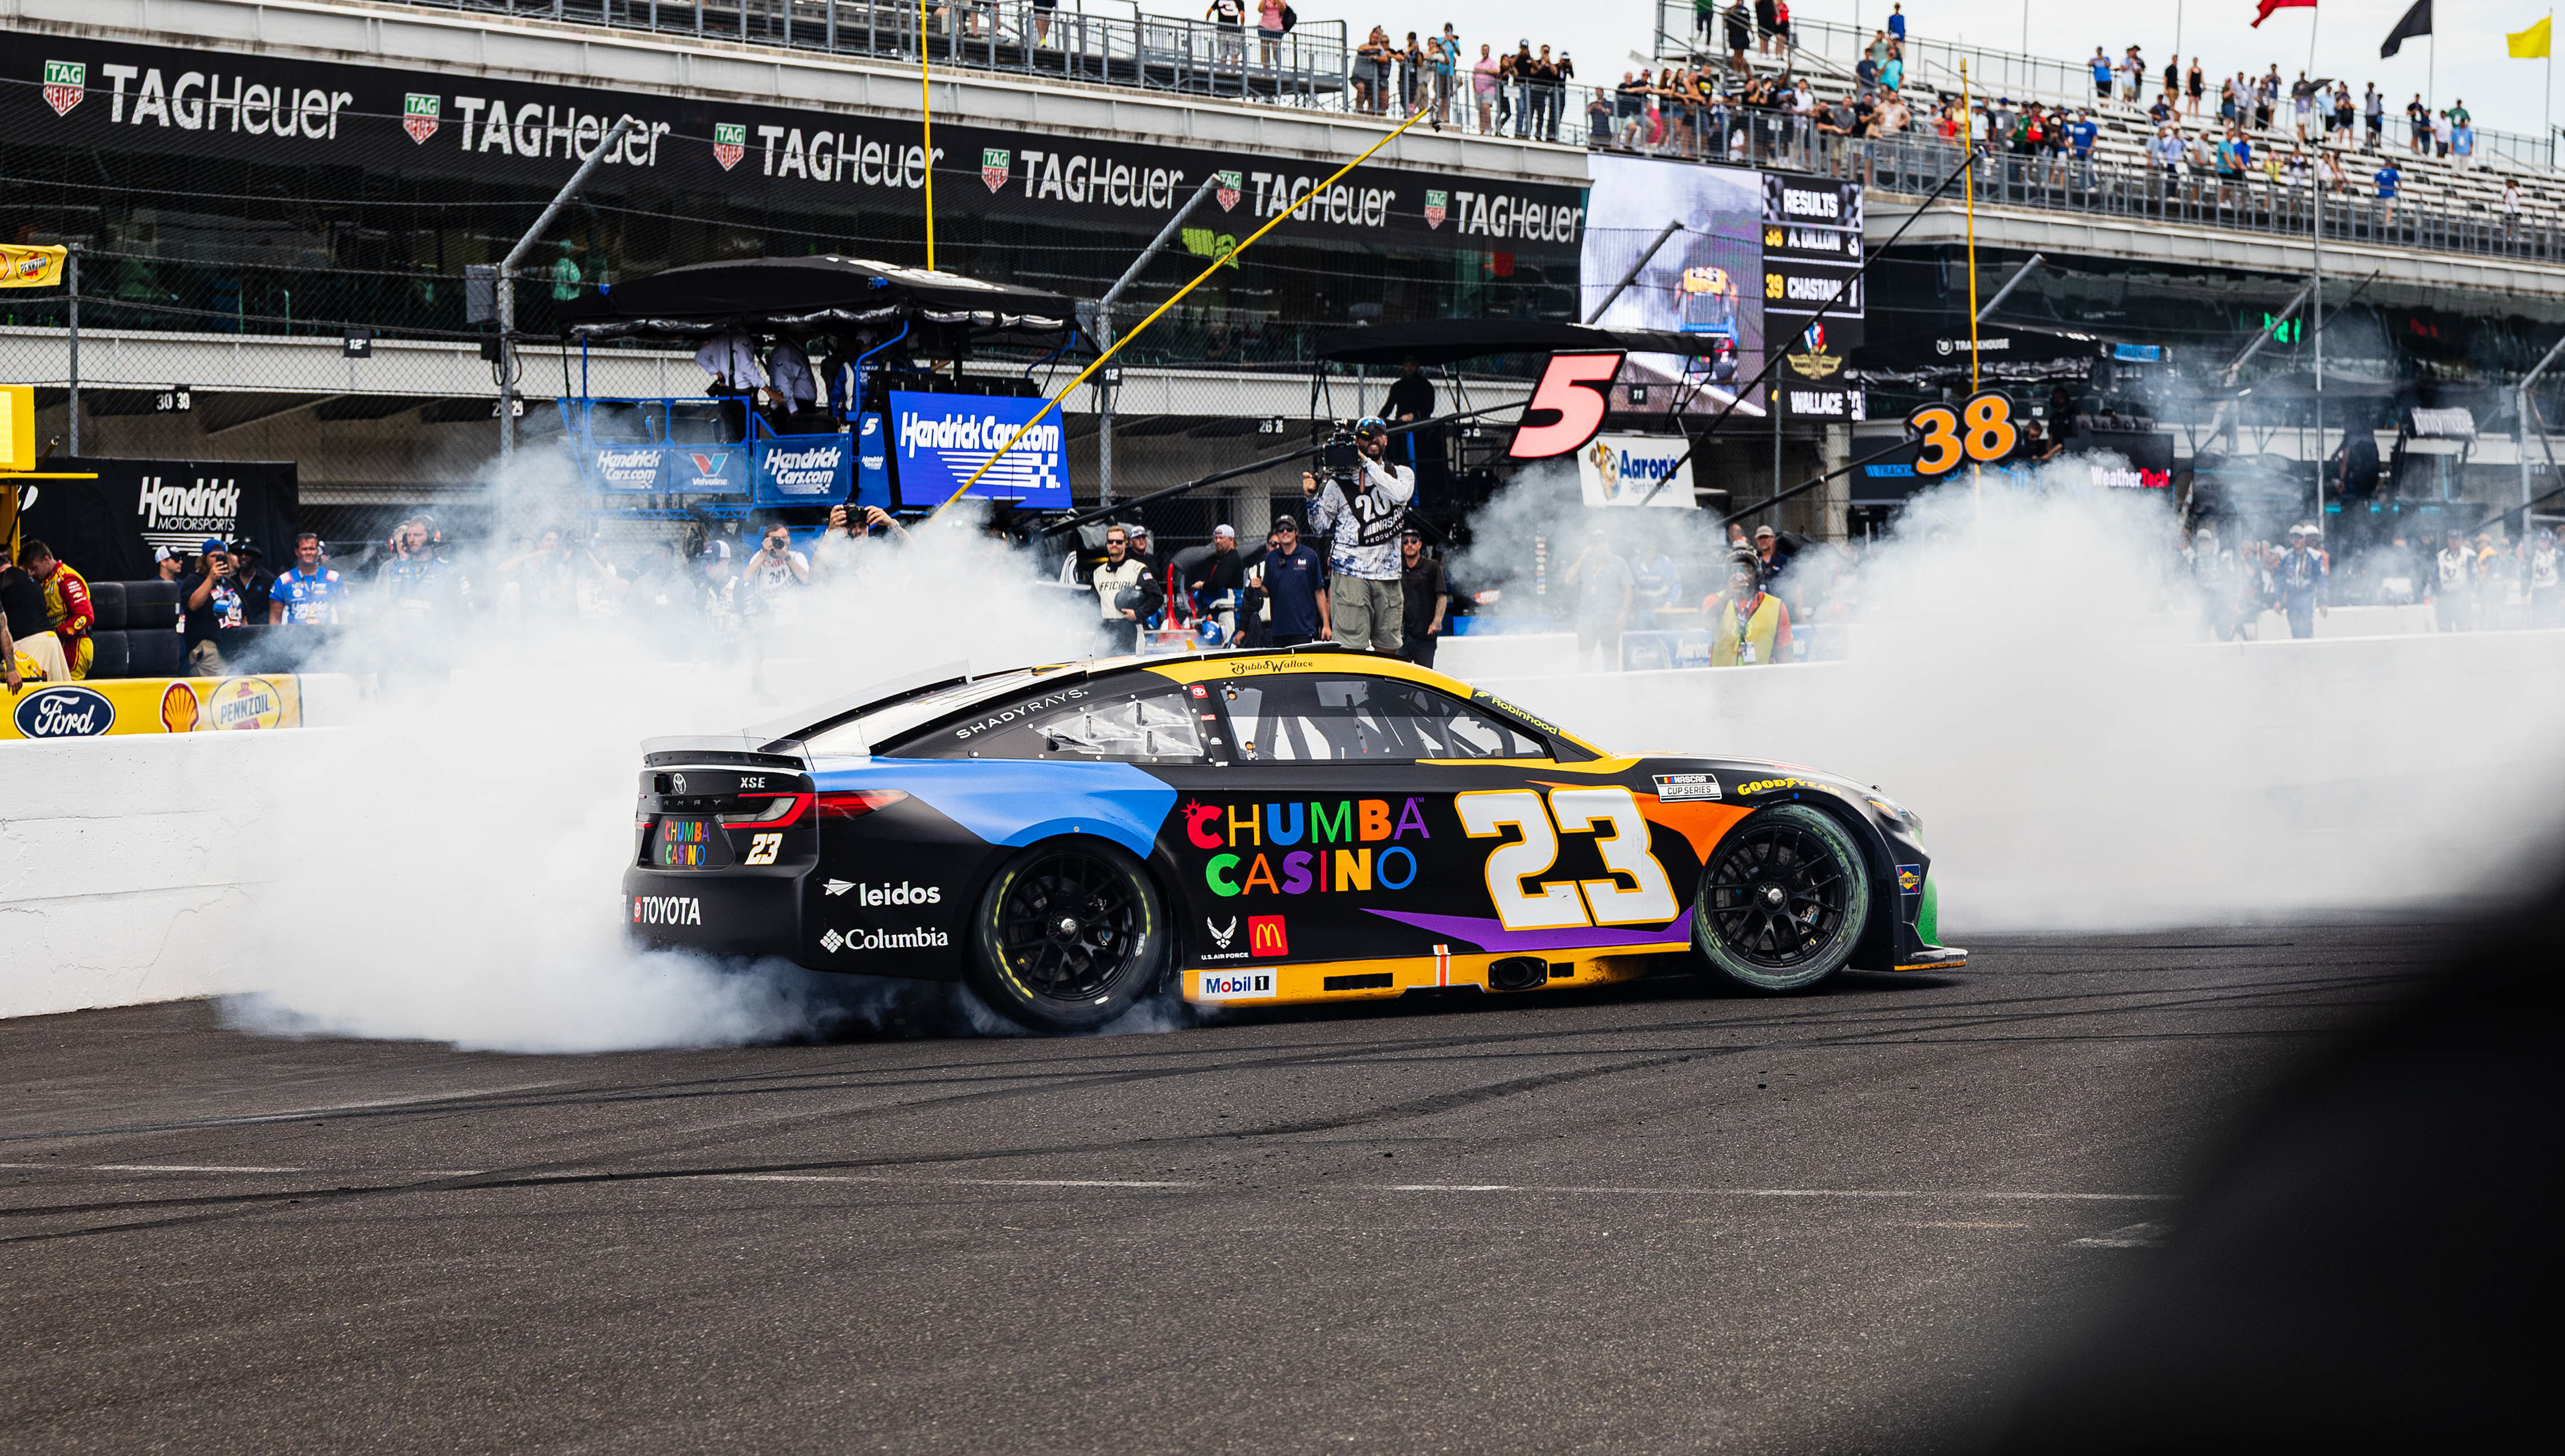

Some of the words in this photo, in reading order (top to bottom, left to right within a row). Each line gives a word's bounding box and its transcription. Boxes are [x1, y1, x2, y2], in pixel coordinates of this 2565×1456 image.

[1218, 0, 1238, 16] 3
[48, 63, 81, 83] TAG
[408, 97, 437, 114] TAG
[718, 126, 743, 142] TAG
[985, 152, 1007, 166] TAG
[1427, 193, 1445, 206] TAG
[1783, 188, 1838, 218] RESULTS
[1801, 228, 1841, 251] DILLON
[1765, 273, 1784, 299] 39
[1849, 279, 1858, 308] 1
[1954, 338, 2010, 351] TRAKHOUSE
[1104, 368, 1120, 380] 12
[156, 393, 173, 410] 30
[176, 392, 190, 409] 30
[1633, 389, 1644, 400] 11
[1790, 391, 1843, 415] WALLACE
[512, 400, 524, 417] 29
[1509, 354, 1621, 458] 5
[861, 417, 879, 435] 5
[1258, 419, 1272, 433] 26
[1911, 395, 2017, 475] 38
[596, 450, 662, 474] Hendrick
[763, 446, 842, 476] Hendrick
[1620, 449, 1678, 480] Aaron's
[605, 468, 657, 483] Cars.com
[691, 477, 728, 486] Valvoline
[776, 469, 834, 485] Cars.com
[2091, 466, 2169, 488] WeatherTech
[1630, 482, 1647, 494] Rent
[138, 476, 241, 528] Hendrick
[1355, 486, 1391, 523] 20
[158, 517, 235, 532] MOTORSPORTS
[1376, 507, 1403, 532] NASAR
[1365, 520, 1404, 544] PRODUCTIO
[1269, 660, 1313, 673] Wallace
[34, 695, 96, 735] Ford
[220, 693, 271, 726] PENNZOIL
[1491, 697, 1558, 735] Robinhood
[740, 777, 765, 789] XSE
[1667, 787, 1683, 795] CUP
[1684, 786, 1711, 794] SERIES
[1673, 775, 1707, 784] NASCAR
[1737, 777, 1842, 796] GOODYEAR
[665, 820, 710, 843] CHUMBA
[1182, 797, 1429, 850] CHUMBA
[665, 844, 706, 866] CASINO
[744, 833, 783, 866] 23
[1454, 785, 1679, 931] 23
[1206, 846, 1417, 897] CASINO
[859, 880, 940, 906] leidos
[642, 896, 701, 926] TOYOTA
[845, 927, 949, 950] Columbia
[1206, 976, 1251, 994] Mobil
[1258, 976, 1264, 990] 1
